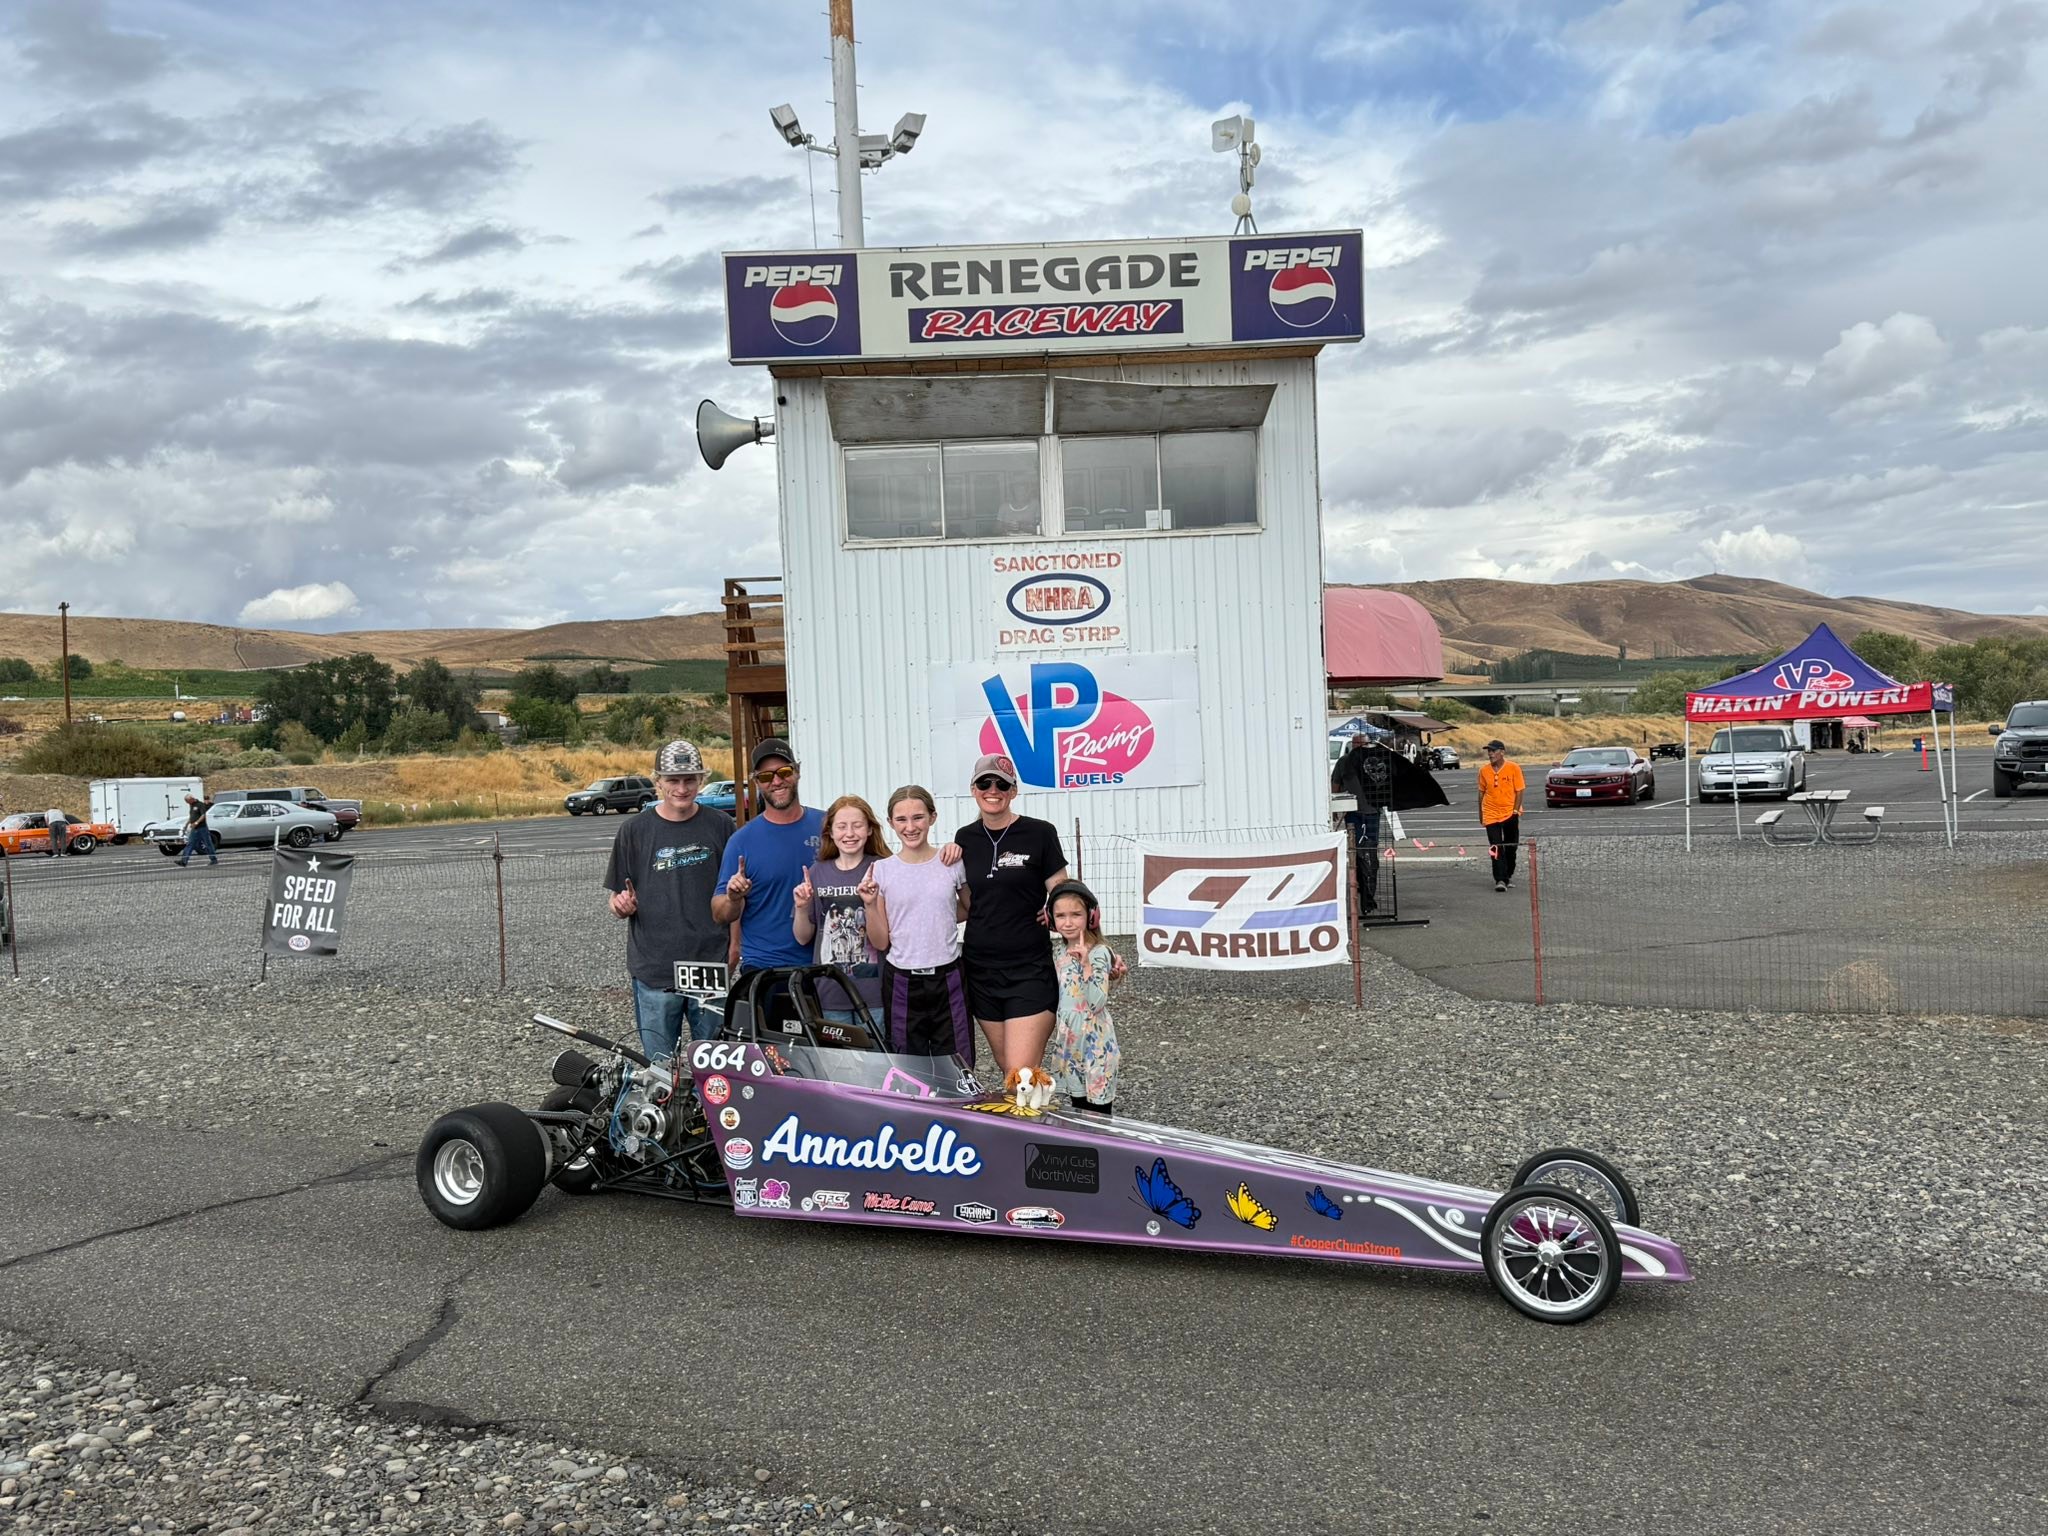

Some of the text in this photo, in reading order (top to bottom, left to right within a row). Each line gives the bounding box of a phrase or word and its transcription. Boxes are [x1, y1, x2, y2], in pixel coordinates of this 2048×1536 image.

[1244, 246, 1341, 270] PEPSI
[744, 264, 842, 288] PEPSI
[890, 252, 1200, 301] RENEGADE
[920, 302, 1172, 340] RACEWAY
[994, 552, 1122, 573] SANCTIONED
[1025, 586, 1095, 612] NHRA
[1000, 626, 1121, 646] DRAG STRIP
[1779, 658, 1832, 690] VP
[1810, 678, 1853, 688] Racing
[1691, 694, 1793, 714] MAKIN'
[982, 662, 1099, 788] VP
[1062, 723, 1154, 772] Racing
[1064, 772, 1124, 787] FUELS
[284, 876, 336, 903] SPEED
[272, 903, 338, 934] FOR ALL.
[1144, 924, 1340, 958] CARRILLO
[678, 966, 725, 990] BELL
[692, 1042, 746, 1072] 664
[762, 1115, 982, 1176] Annabelle
[1042, 1153, 1096, 1168] Vinyl Cuts
[1032, 1168, 1096, 1184] NorthWest
[960, 1206, 992, 1218] COCHRAN
[1290, 1234, 1401, 1262] #CooperChunStrong
